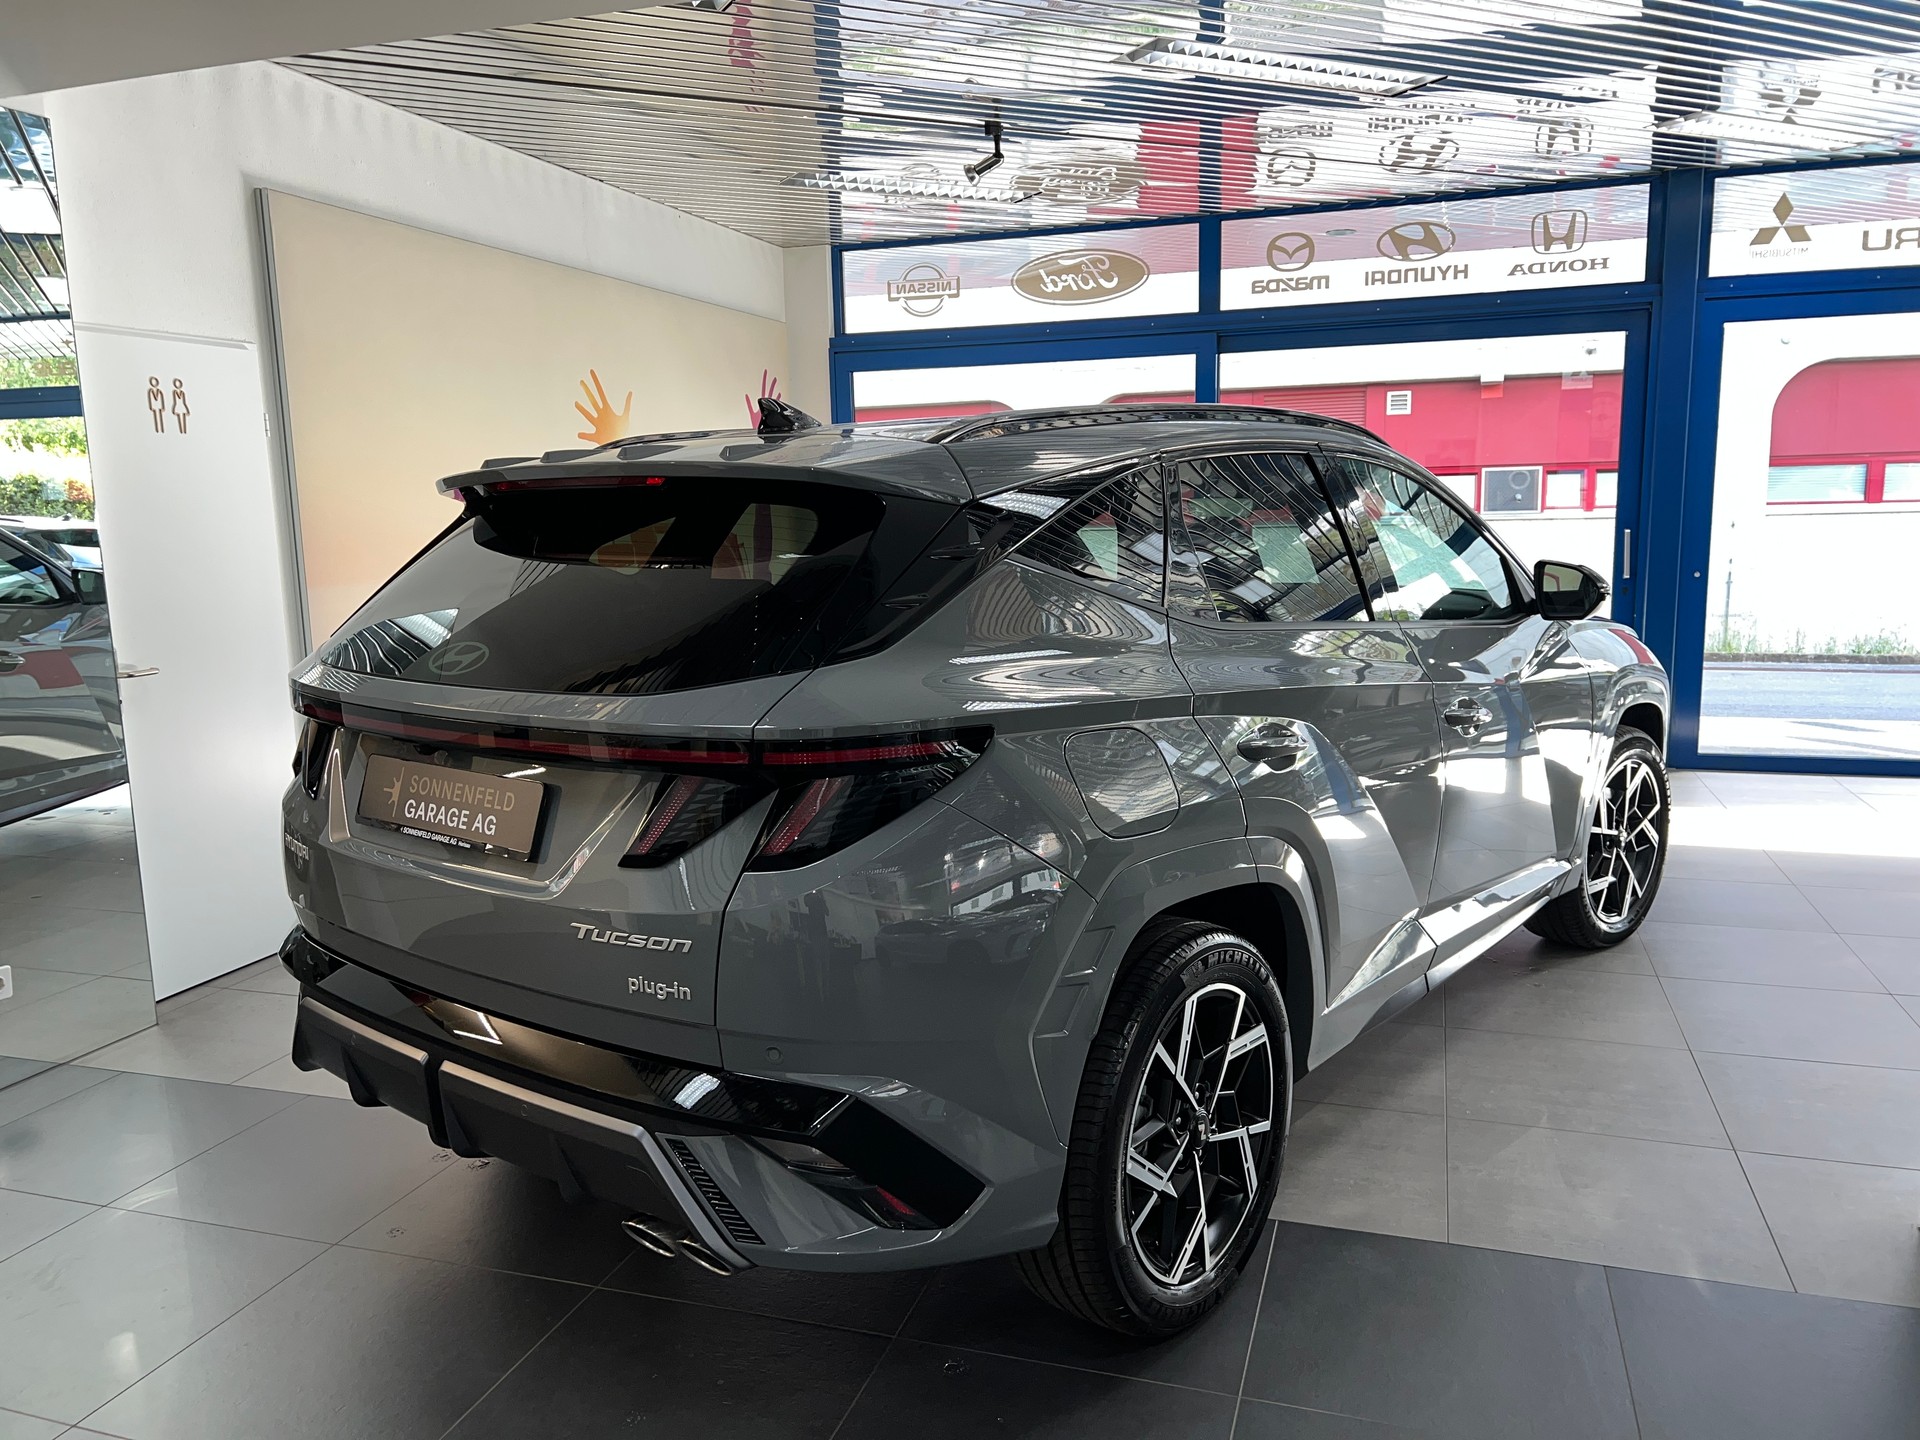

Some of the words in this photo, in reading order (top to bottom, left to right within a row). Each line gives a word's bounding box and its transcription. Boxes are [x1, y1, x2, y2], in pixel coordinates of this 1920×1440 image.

[409, 775, 515, 811] SONNENFELD
[404, 799, 470, 830] GARAGE
[471, 813, 497, 836] AG
[403, 827, 432, 839] SONNENFELD
[431, 833, 450, 844] GARAGE
[1207, 950, 1268, 981] MICHELIN
[628, 975, 691, 1001] plug-in
